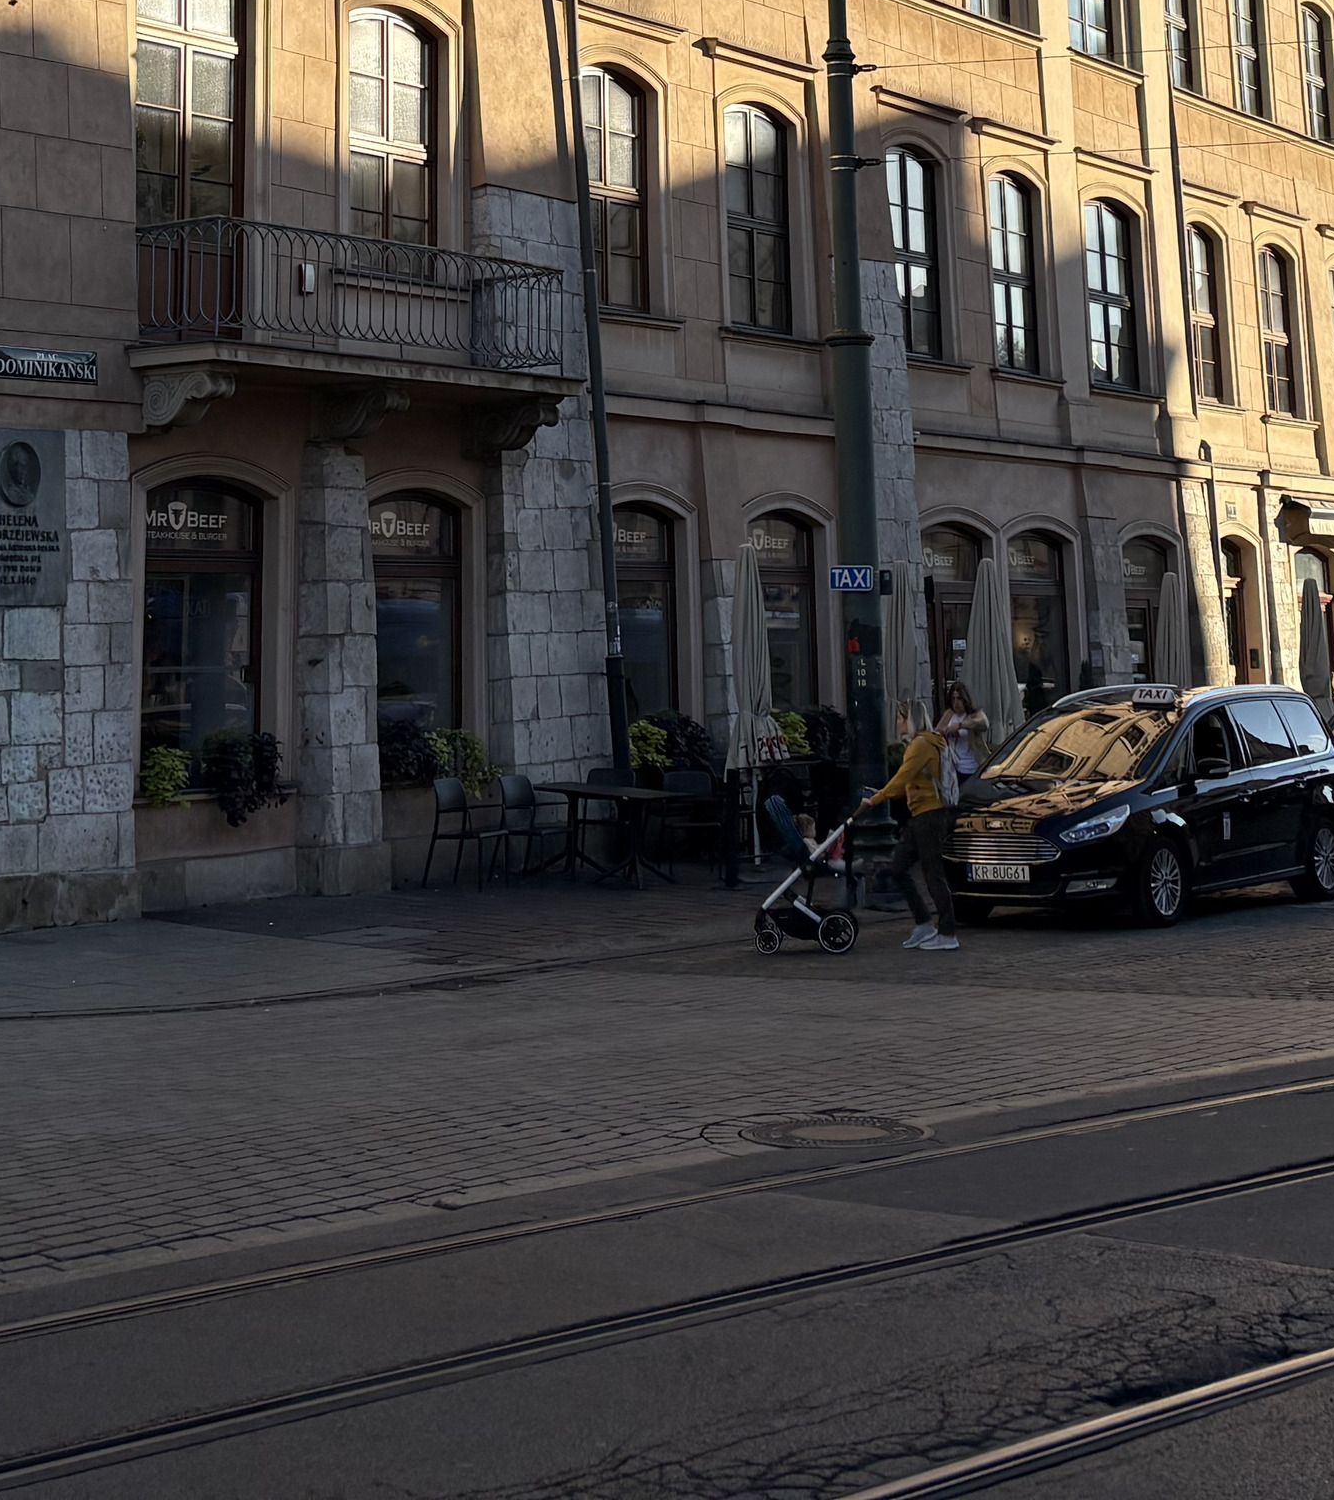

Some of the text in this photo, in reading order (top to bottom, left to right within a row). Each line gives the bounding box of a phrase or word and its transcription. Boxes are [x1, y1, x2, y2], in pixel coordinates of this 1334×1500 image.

[36, 351, 58, 360] PLAC
[187, 511, 228, 529] BEEF
[396, 520, 431, 537] BEEF
[617, 528, 647, 543] BEEF
[764, 535, 790, 549] BEEF
[831, 568, 871, 589] TAXI
[857, 668, 867, 677] 10
[1139, 689, 1168, 700] TAXI
[974, 865, 1026, 880] KR 8UG61
